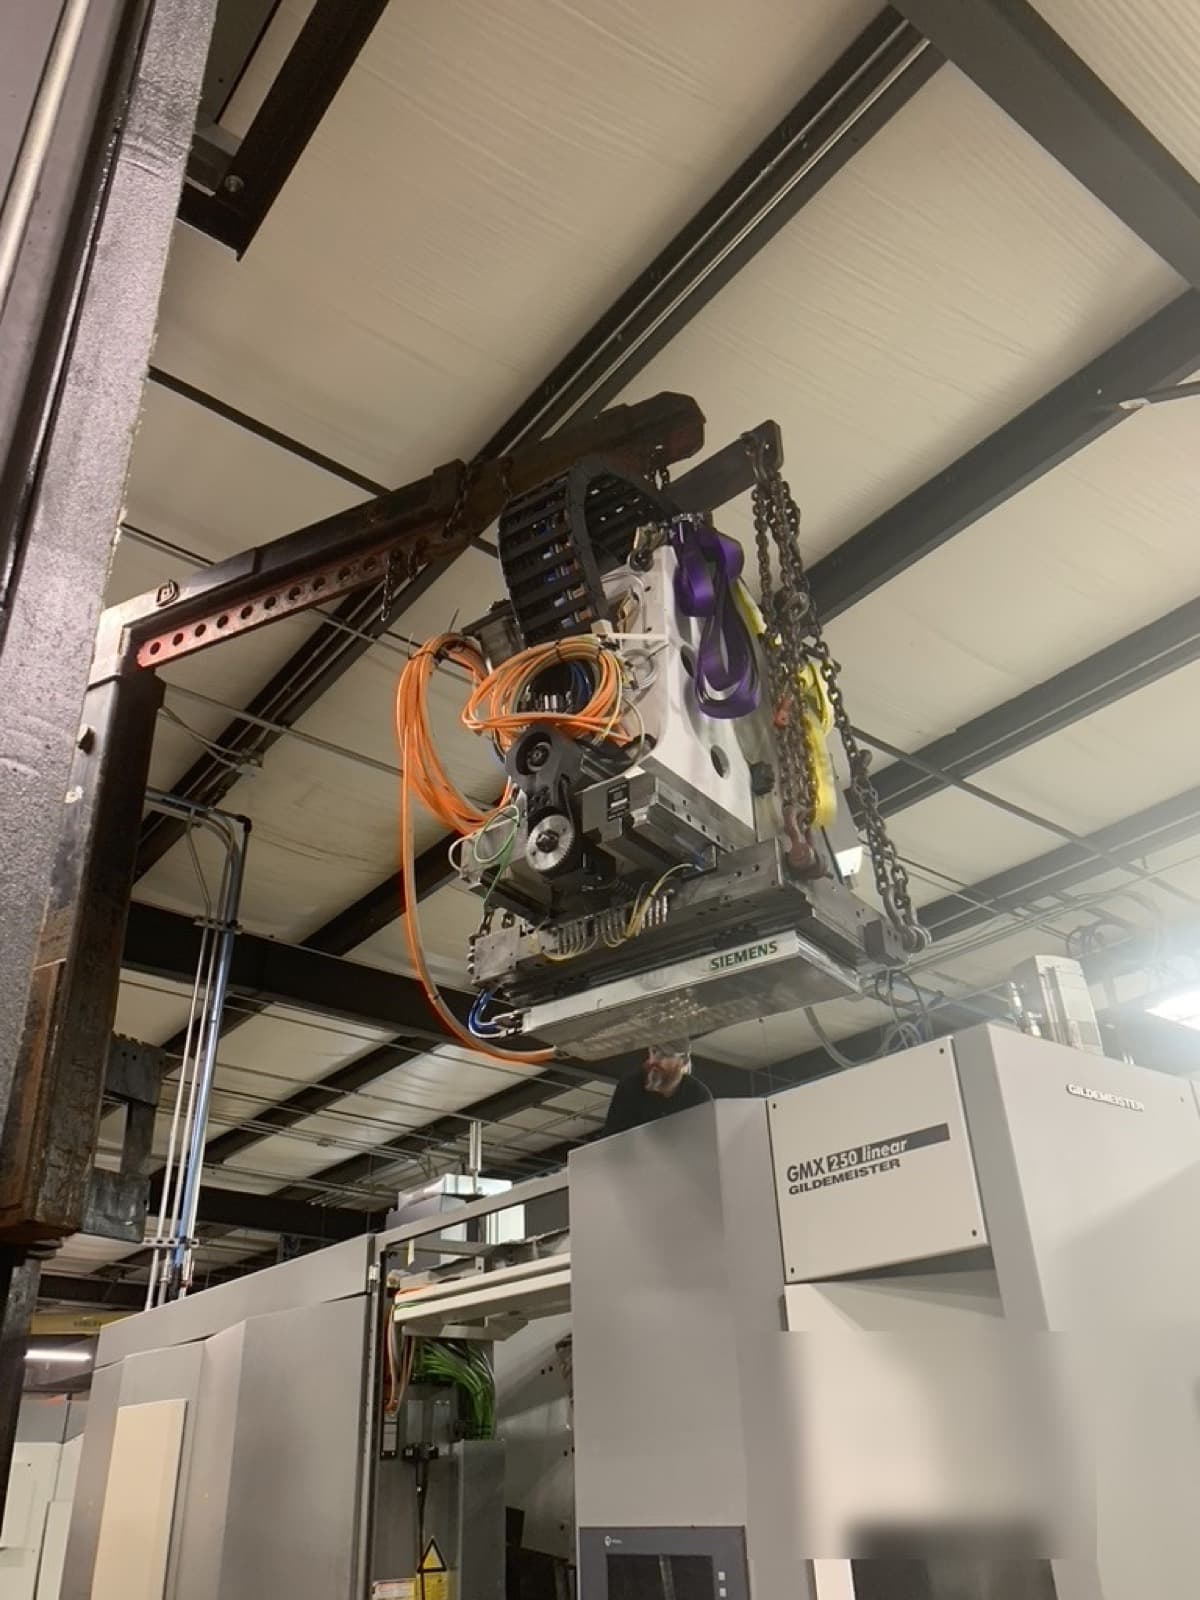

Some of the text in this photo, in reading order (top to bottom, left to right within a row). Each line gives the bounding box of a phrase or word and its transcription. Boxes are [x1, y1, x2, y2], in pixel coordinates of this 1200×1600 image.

[711, 940, 778, 970] SIEMENS
[787, 1139, 907, 1183] GMX 250 linear
[788, 1158, 901, 1195] GILDEMEISTER
